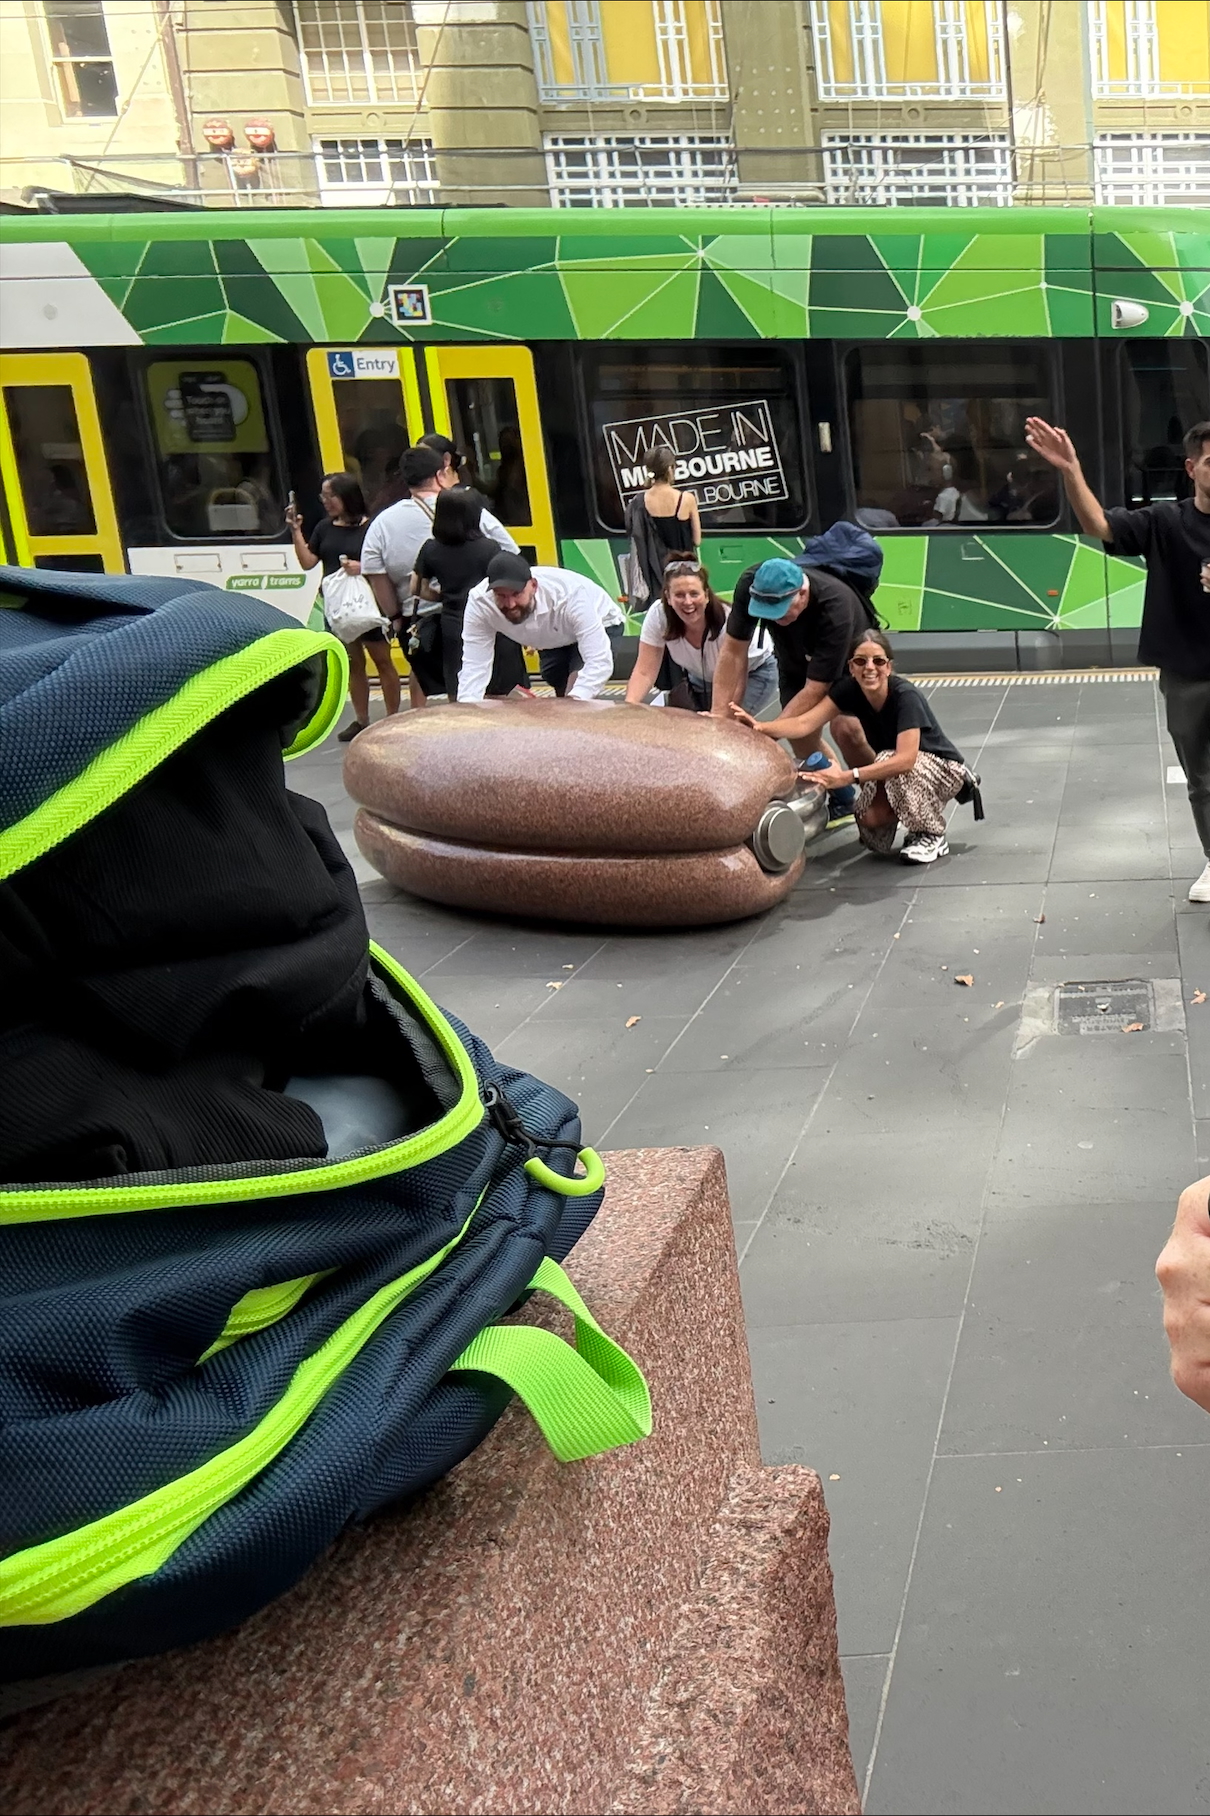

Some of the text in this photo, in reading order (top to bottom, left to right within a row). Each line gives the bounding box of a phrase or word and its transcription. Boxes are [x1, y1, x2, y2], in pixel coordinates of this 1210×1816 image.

[356, 358, 395, 374] Entry
[610, 408, 769, 465] MADE IN
[620, 446, 775, 488] MBOURNE
[231, 576, 301, 588] yarra trams
